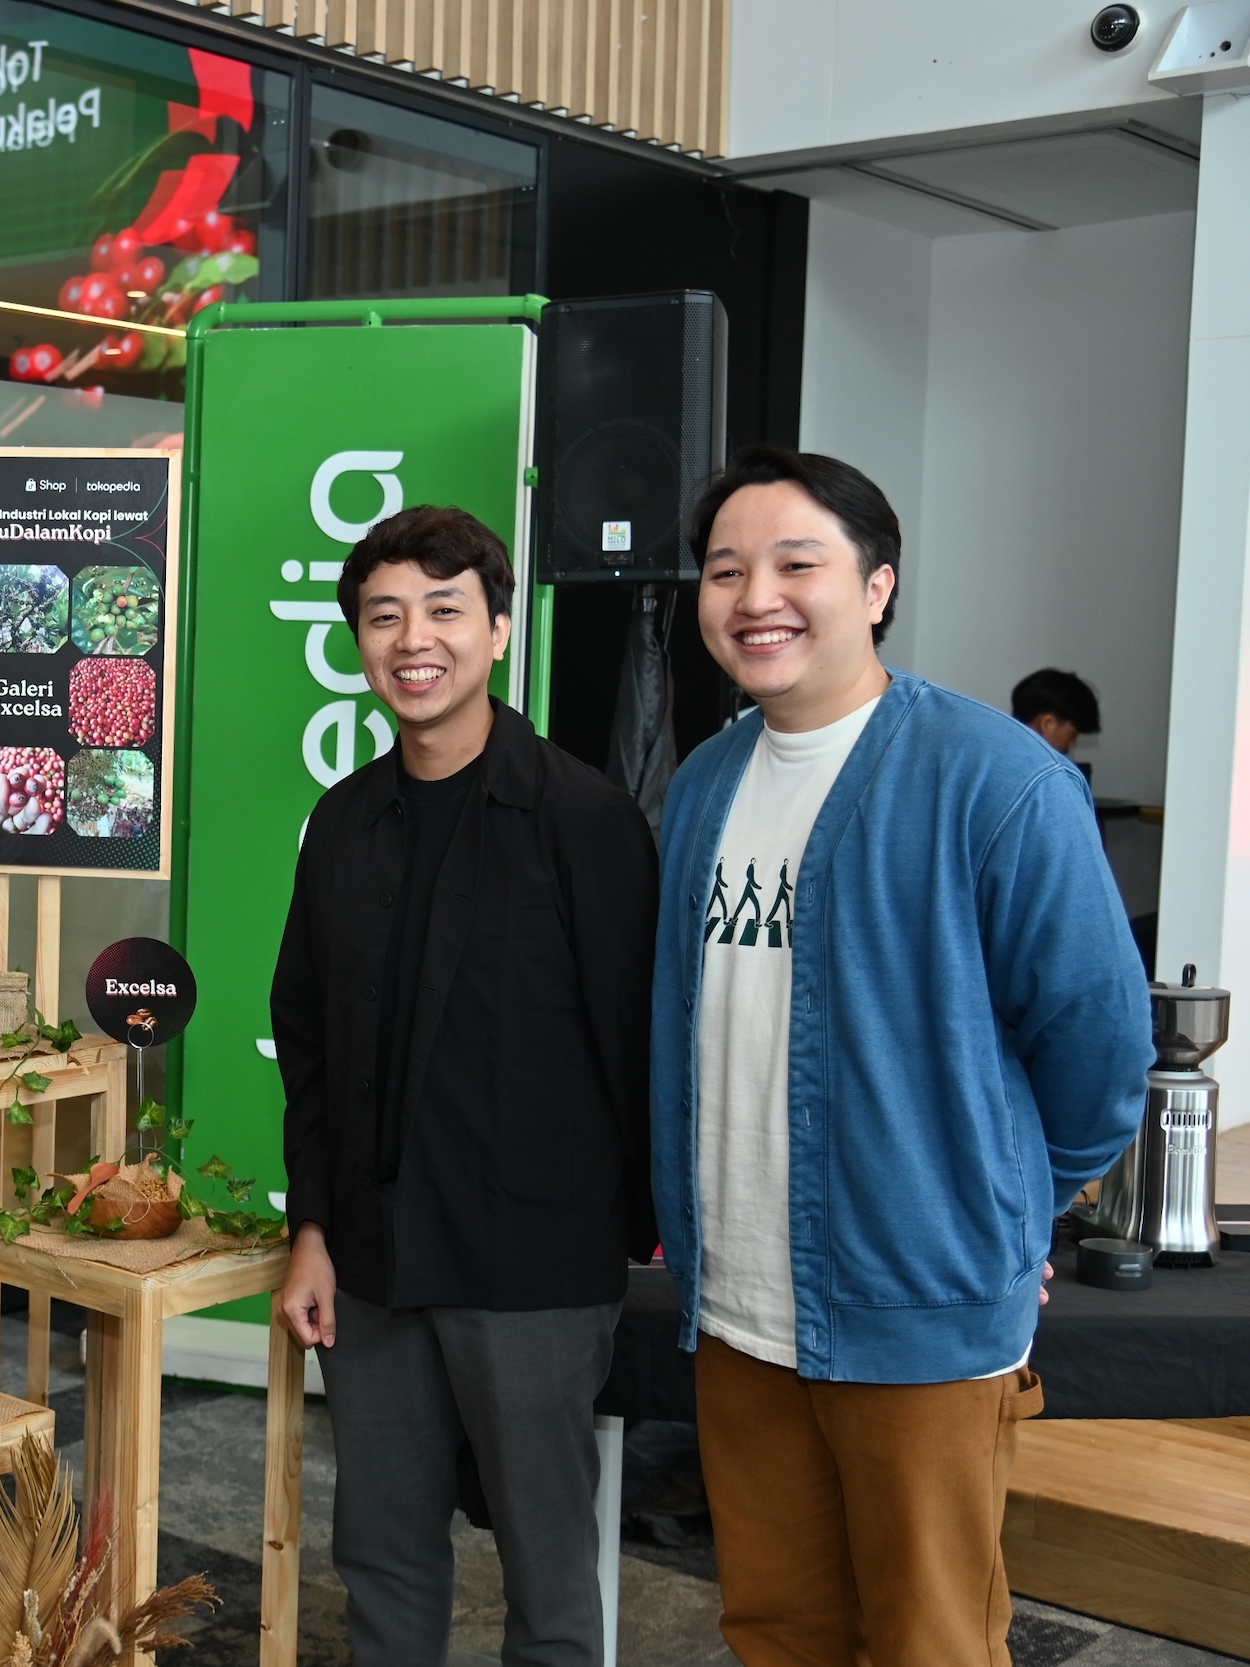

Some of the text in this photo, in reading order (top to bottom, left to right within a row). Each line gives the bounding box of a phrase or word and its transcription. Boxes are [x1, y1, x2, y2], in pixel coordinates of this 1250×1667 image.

[39, 480, 141, 493] Shop tokopedia
[0, 509, 47, 520] Industri
[49, 509, 81, 520] Lokal
[83, 510, 112, 524] Kopi
[113, 510, 149, 521] lewat
[105, 979, 177, 996] Excelsa
